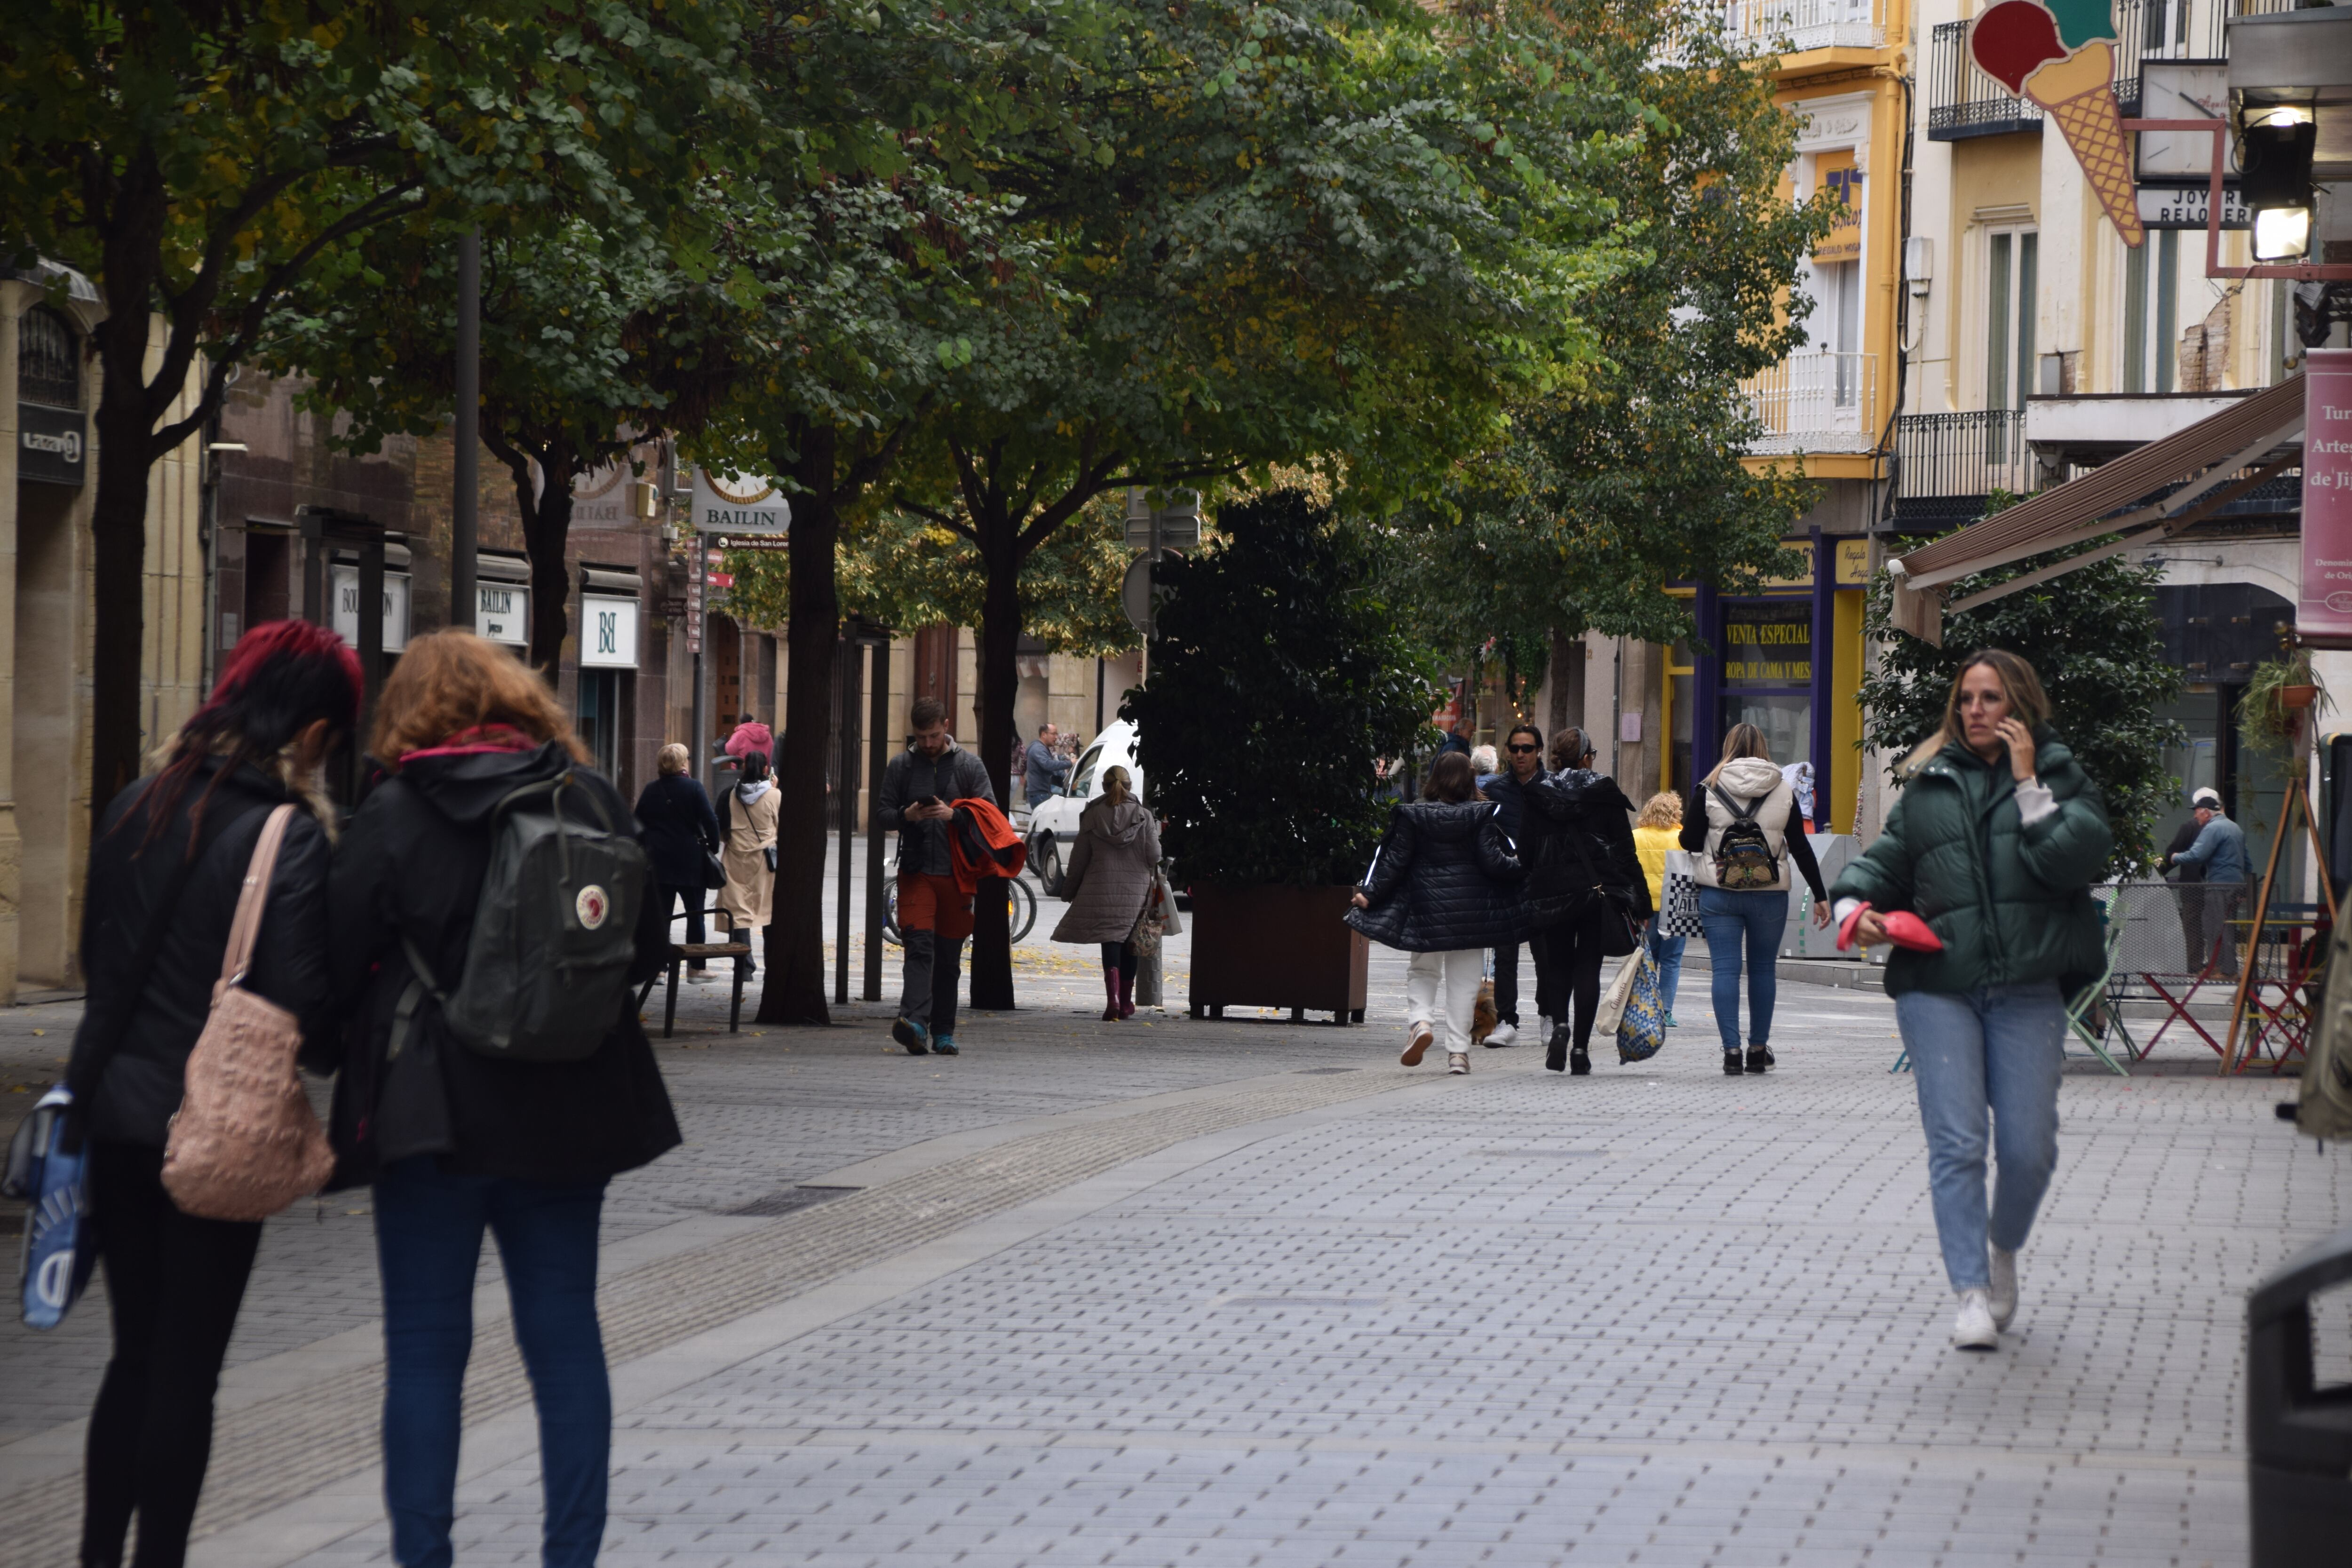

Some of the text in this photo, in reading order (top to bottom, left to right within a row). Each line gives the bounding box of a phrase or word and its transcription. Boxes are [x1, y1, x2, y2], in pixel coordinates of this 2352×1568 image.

[2173, 190, 2235, 204] JOYR
[2161, 207, 2247, 222] RELOER
[2310, 471, 2331, 486] de
[706, 509, 776, 525] BAILIN
[731, 539, 750, 548] Iglesia
[1844, 545, 1866, 565] Regalo
[480, 589, 511, 613] BAILIN
[1726, 624, 1810, 644] VENTA ESPECIAL
[1725, 661, 1812, 678] ROPA DE CAMA Y MES
